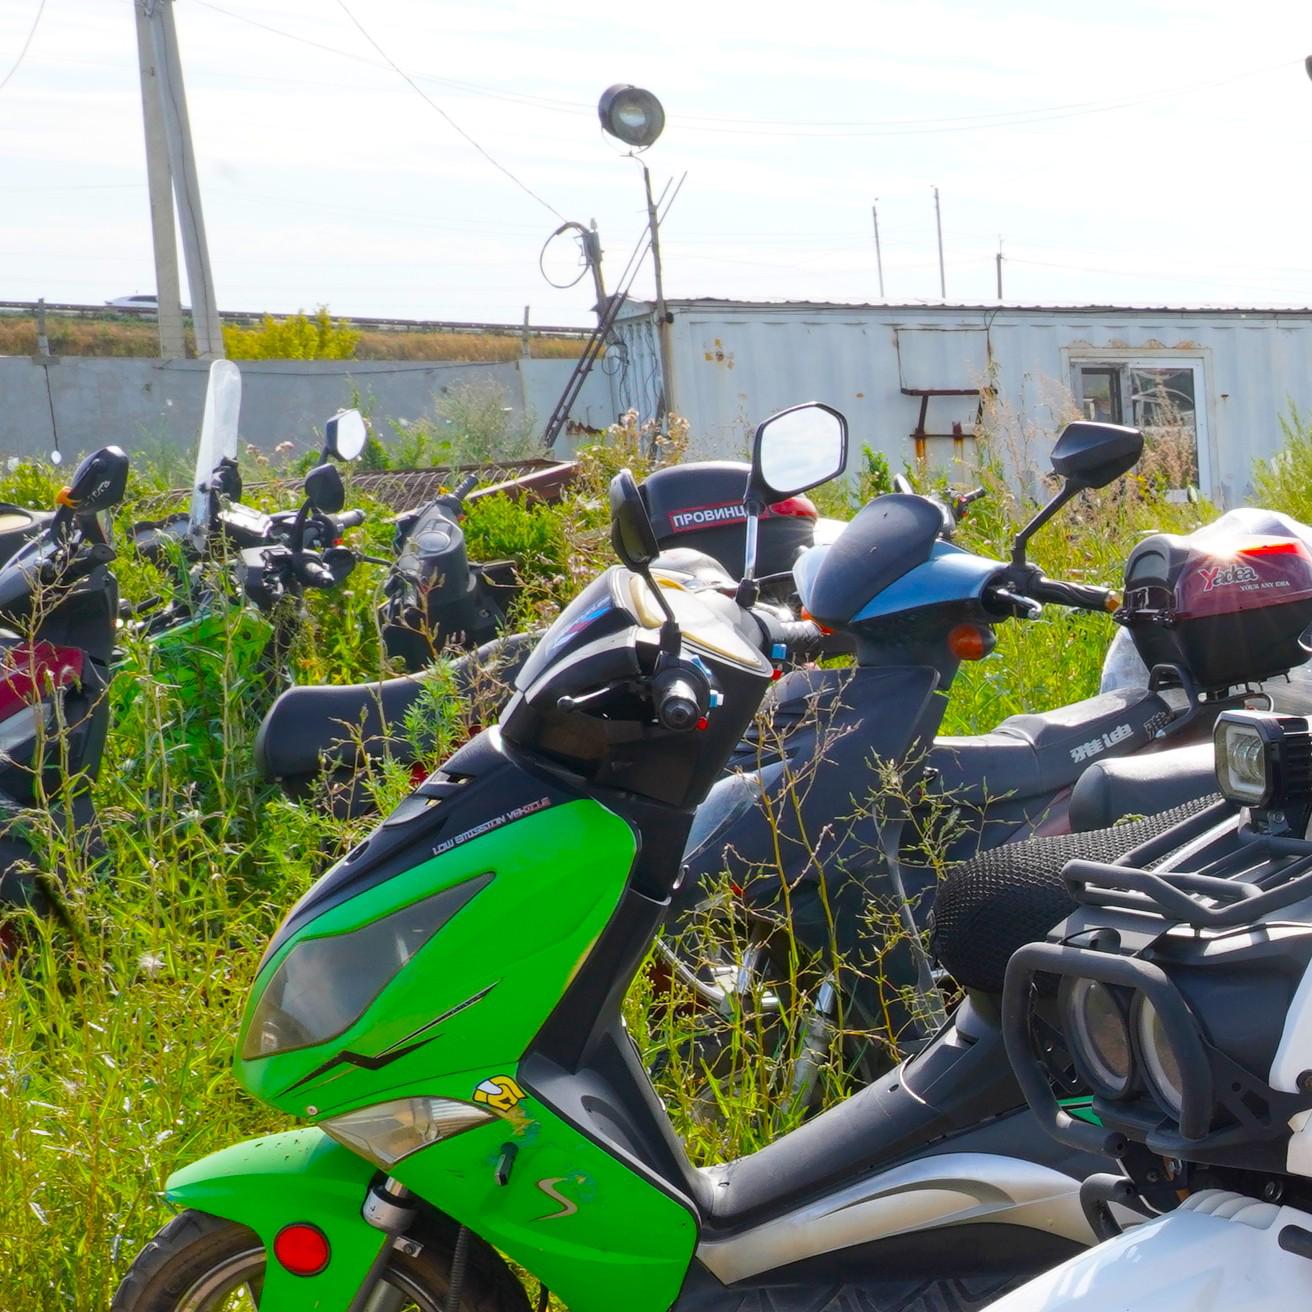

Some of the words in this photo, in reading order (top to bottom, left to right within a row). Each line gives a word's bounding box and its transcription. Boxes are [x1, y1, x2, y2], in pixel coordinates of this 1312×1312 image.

[672, 504, 748, 528] ПРОВИНЦ
[1199, 565, 1259, 592] Yadea
[432, 839, 455, 855] LOW
